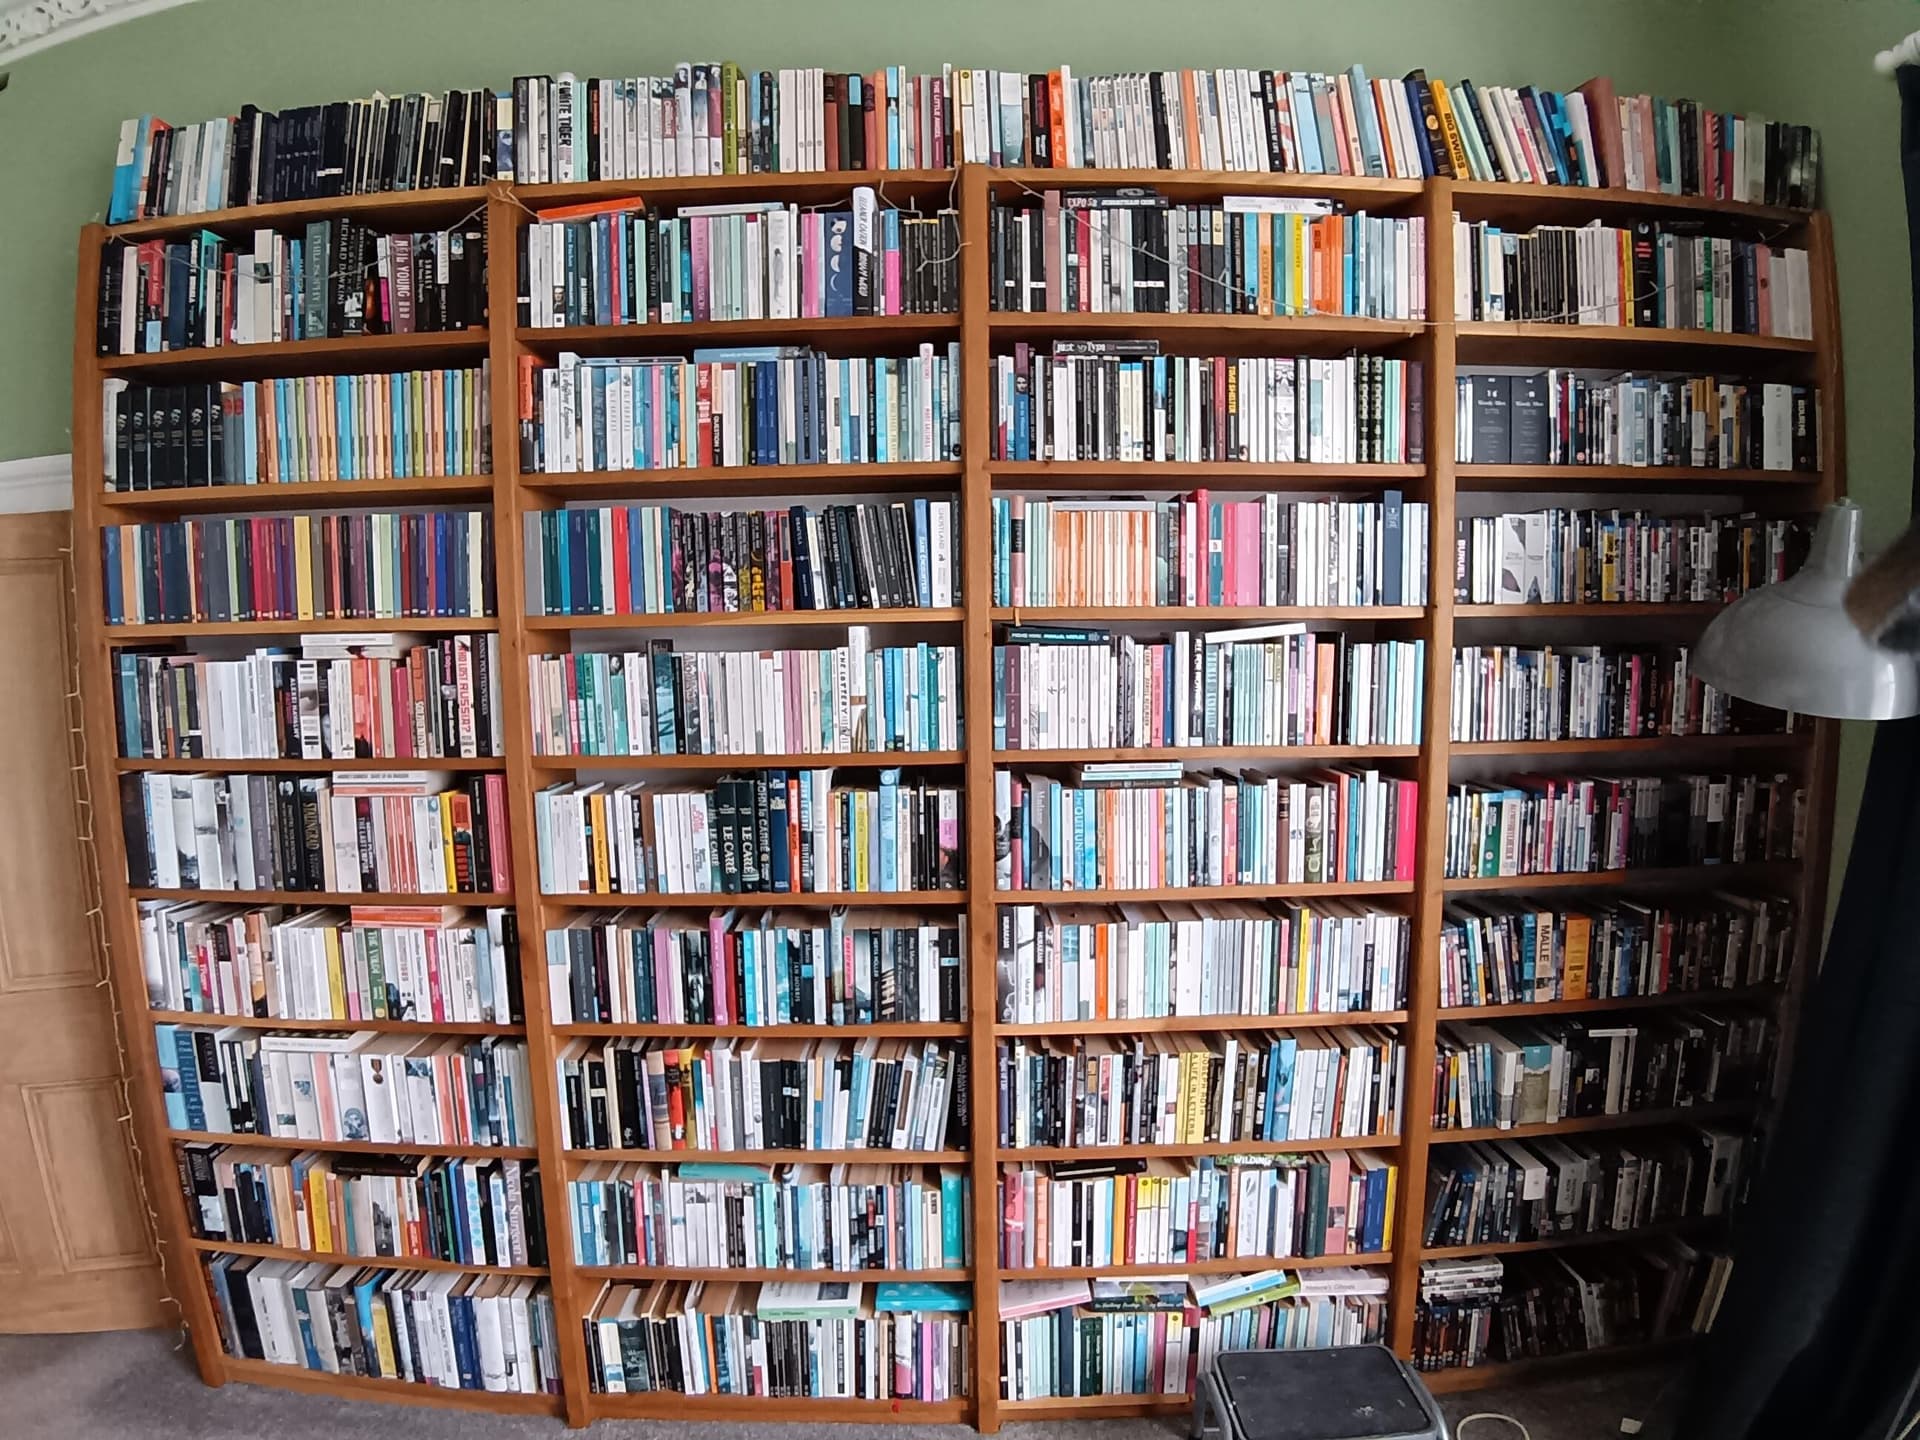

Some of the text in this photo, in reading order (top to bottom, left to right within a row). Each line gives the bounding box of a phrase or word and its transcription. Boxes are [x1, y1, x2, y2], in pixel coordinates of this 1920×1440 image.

[933, 80, 941, 93] THE
[558, 115, 572, 146] TIGER
[1443, 112, 1466, 170] BIG SWISS
[337, 218, 350, 305] RICHARD DAWKINS
[396, 266, 411, 297] YOUNG
[302, 801, 319, 851] STALINGRAD
[723, 826, 733, 840] LE
[741, 826, 752, 840] LE
[1540, 925, 1550, 961] MALLE
[1234, 1156, 1272, 1168] WILDING
[505, 1166, 522, 1255] Nicola Sturgeon
